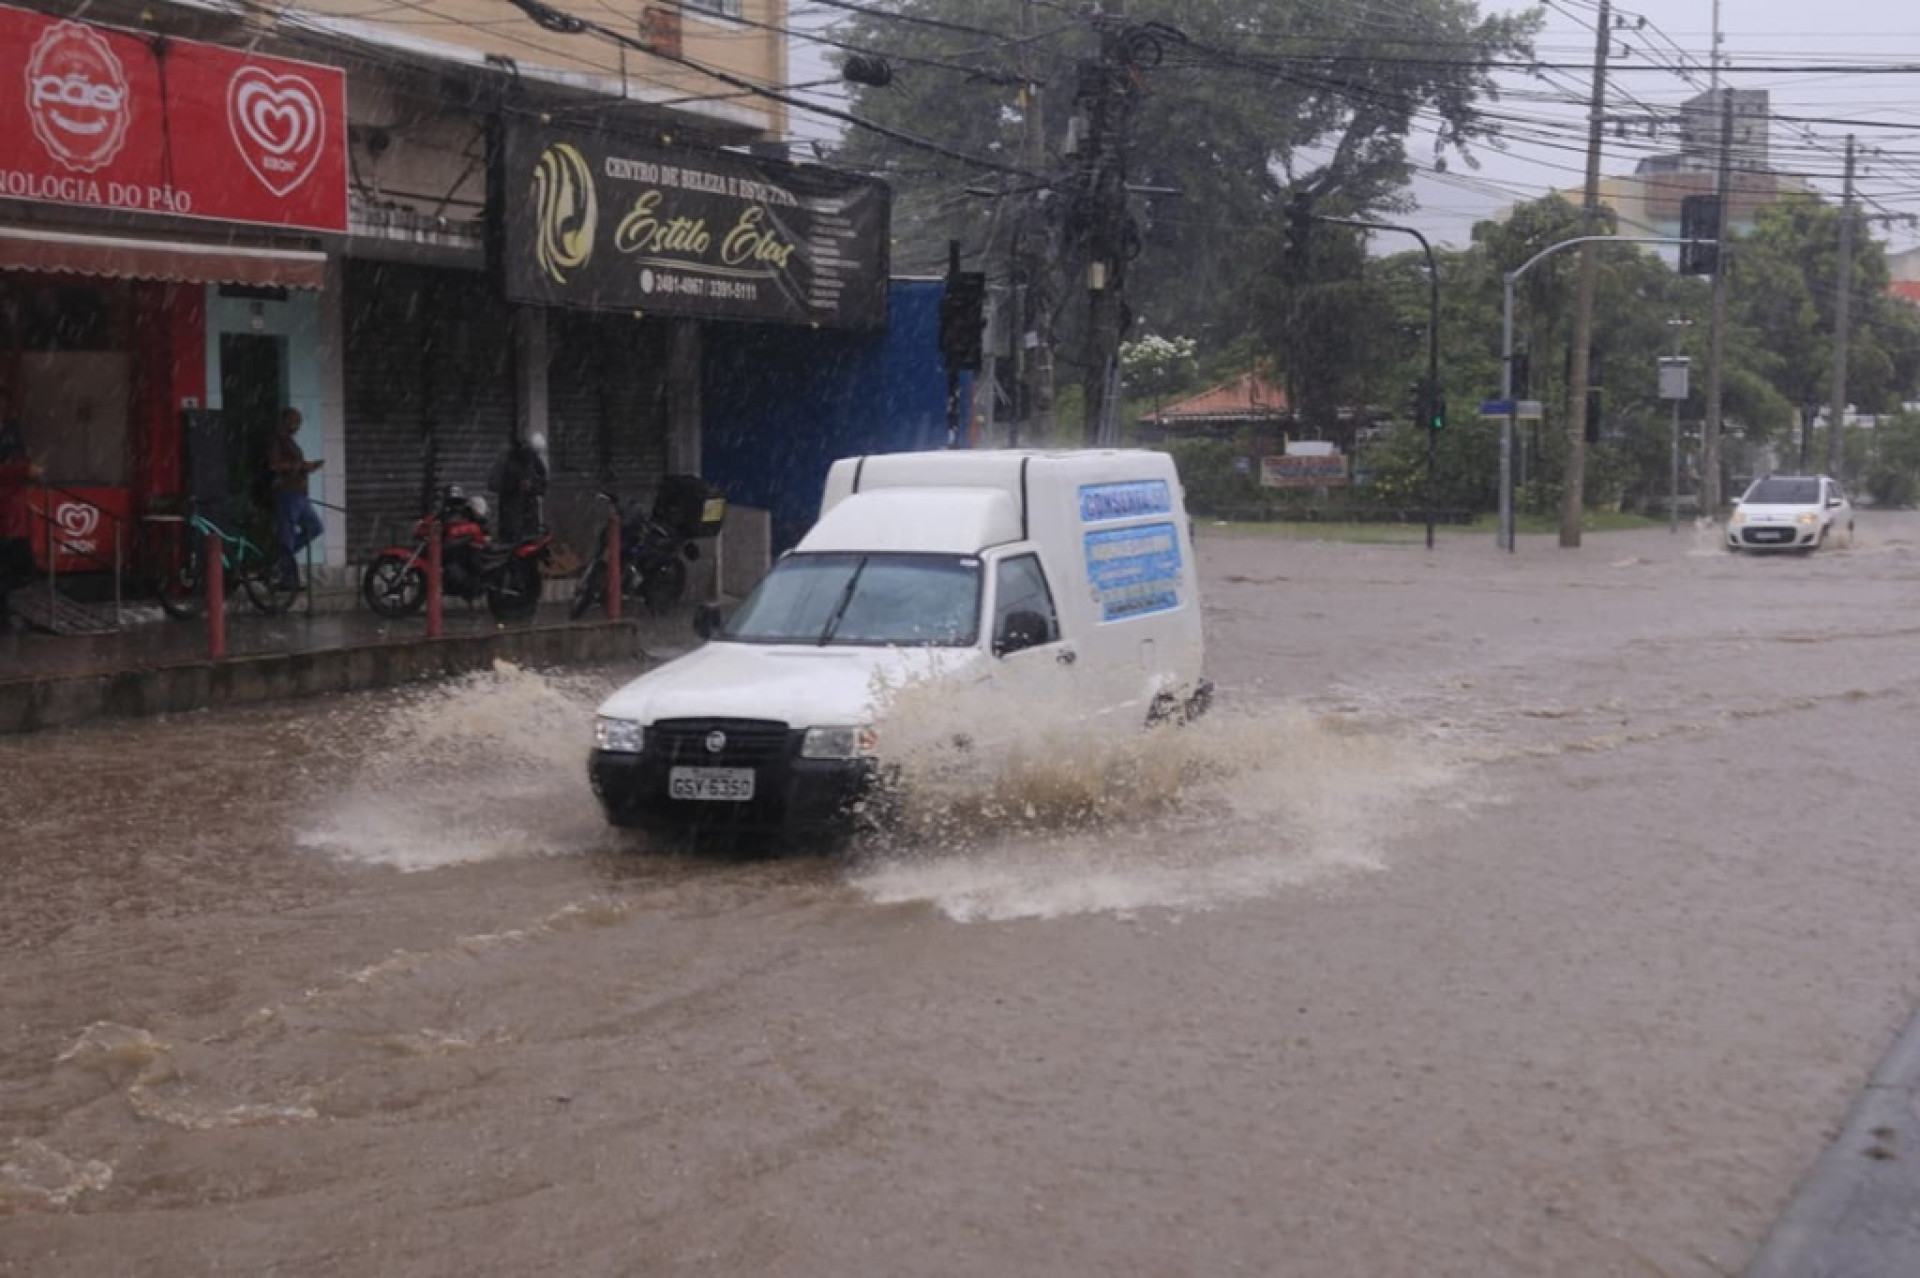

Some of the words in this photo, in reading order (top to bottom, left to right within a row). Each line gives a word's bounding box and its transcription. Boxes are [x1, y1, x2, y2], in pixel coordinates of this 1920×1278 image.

[605, 156, 658, 184] CENTRO
[661, 164, 679, 188] DE
[681, 168, 726, 195] BELEZA
[108, 182, 141, 208] DO
[148, 184, 192, 213] PÃO
[615, 190, 710, 253] Estilo
[722, 206, 795, 268] Elas
